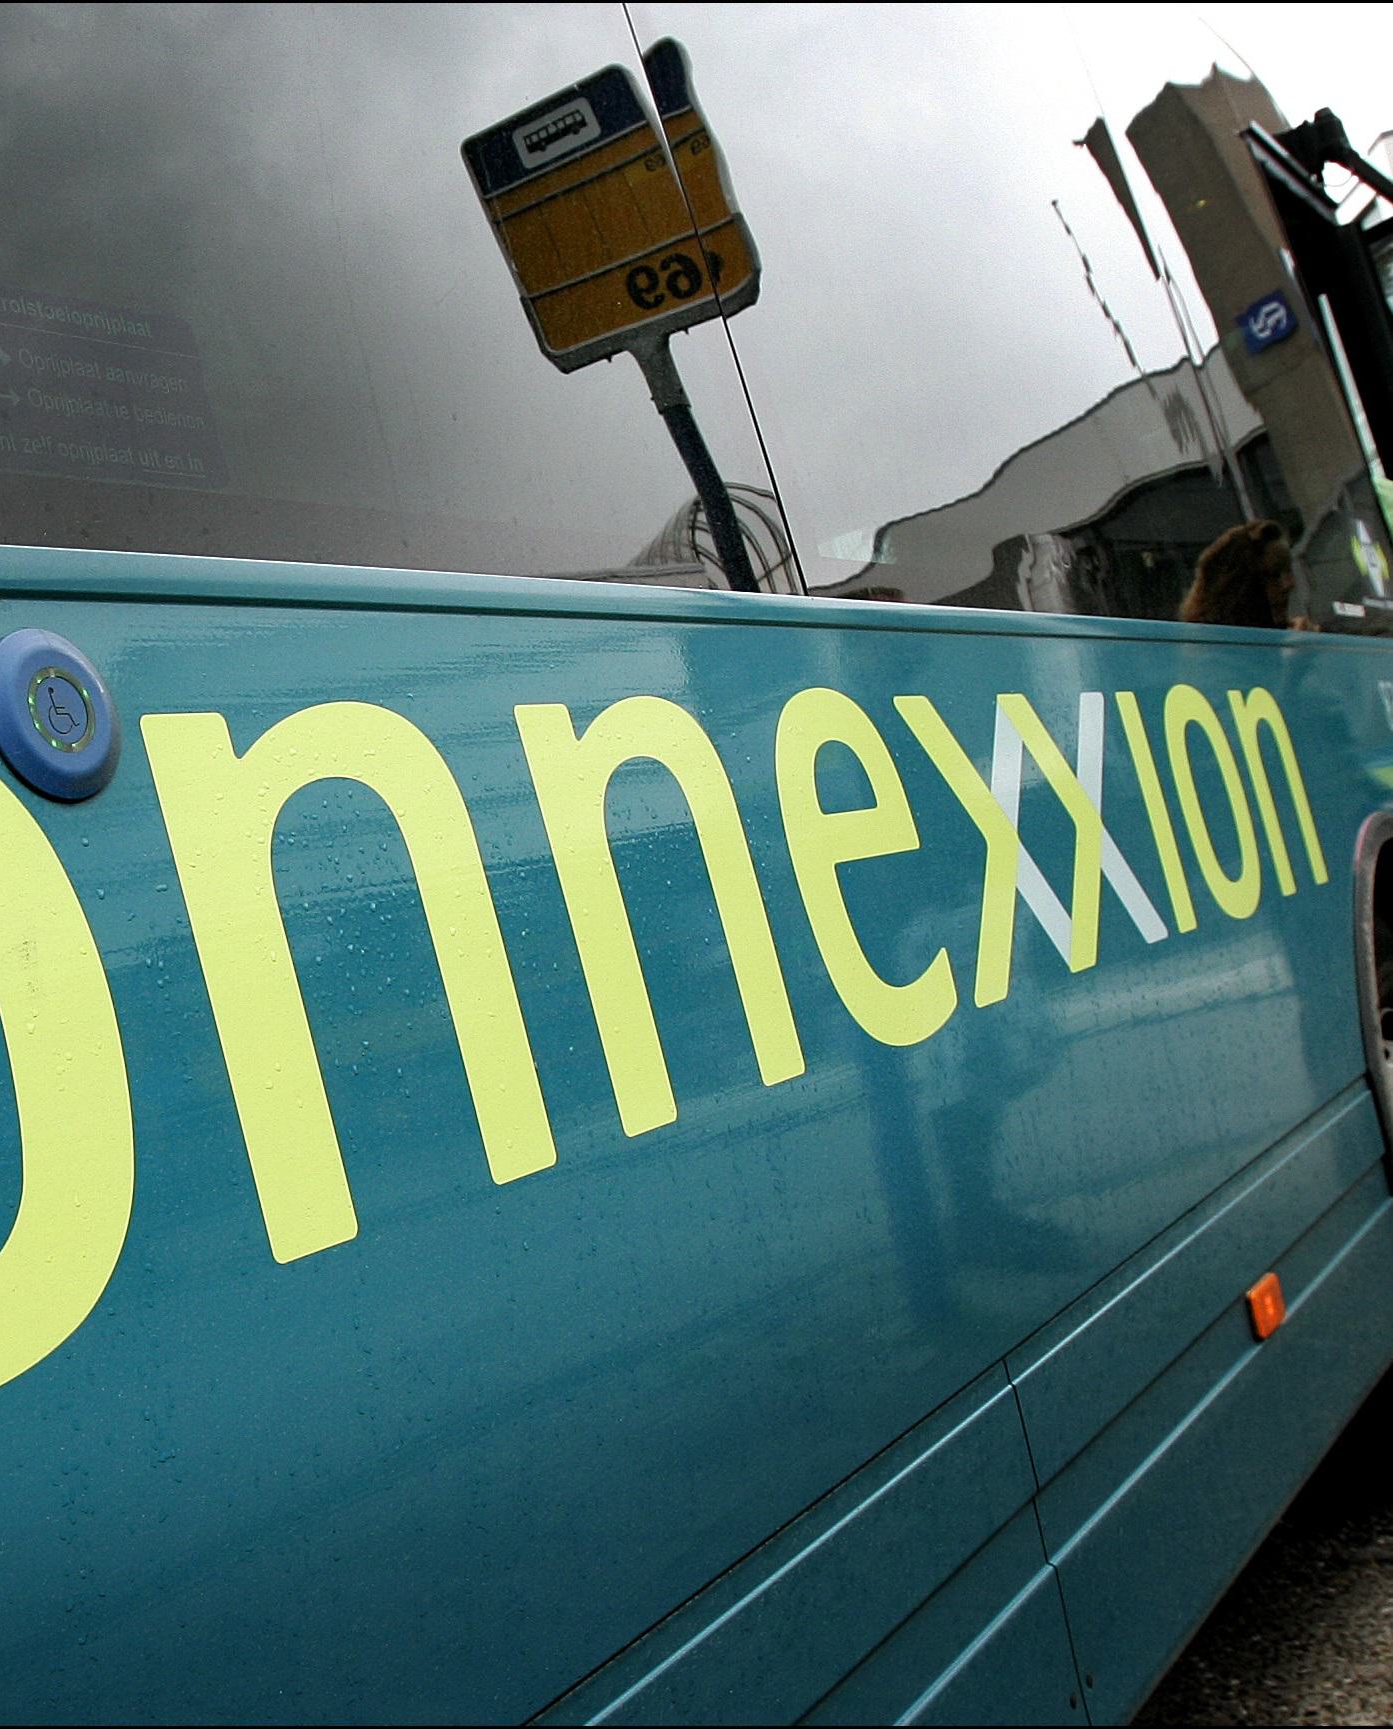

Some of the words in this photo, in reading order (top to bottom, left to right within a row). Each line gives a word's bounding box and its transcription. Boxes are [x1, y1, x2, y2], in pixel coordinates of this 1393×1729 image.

[0, 297, 153, 338] rolstoeloprijplaat
[18, 349, 101, 379] Oprijplaat
[22, 434, 54, 455] zelf
